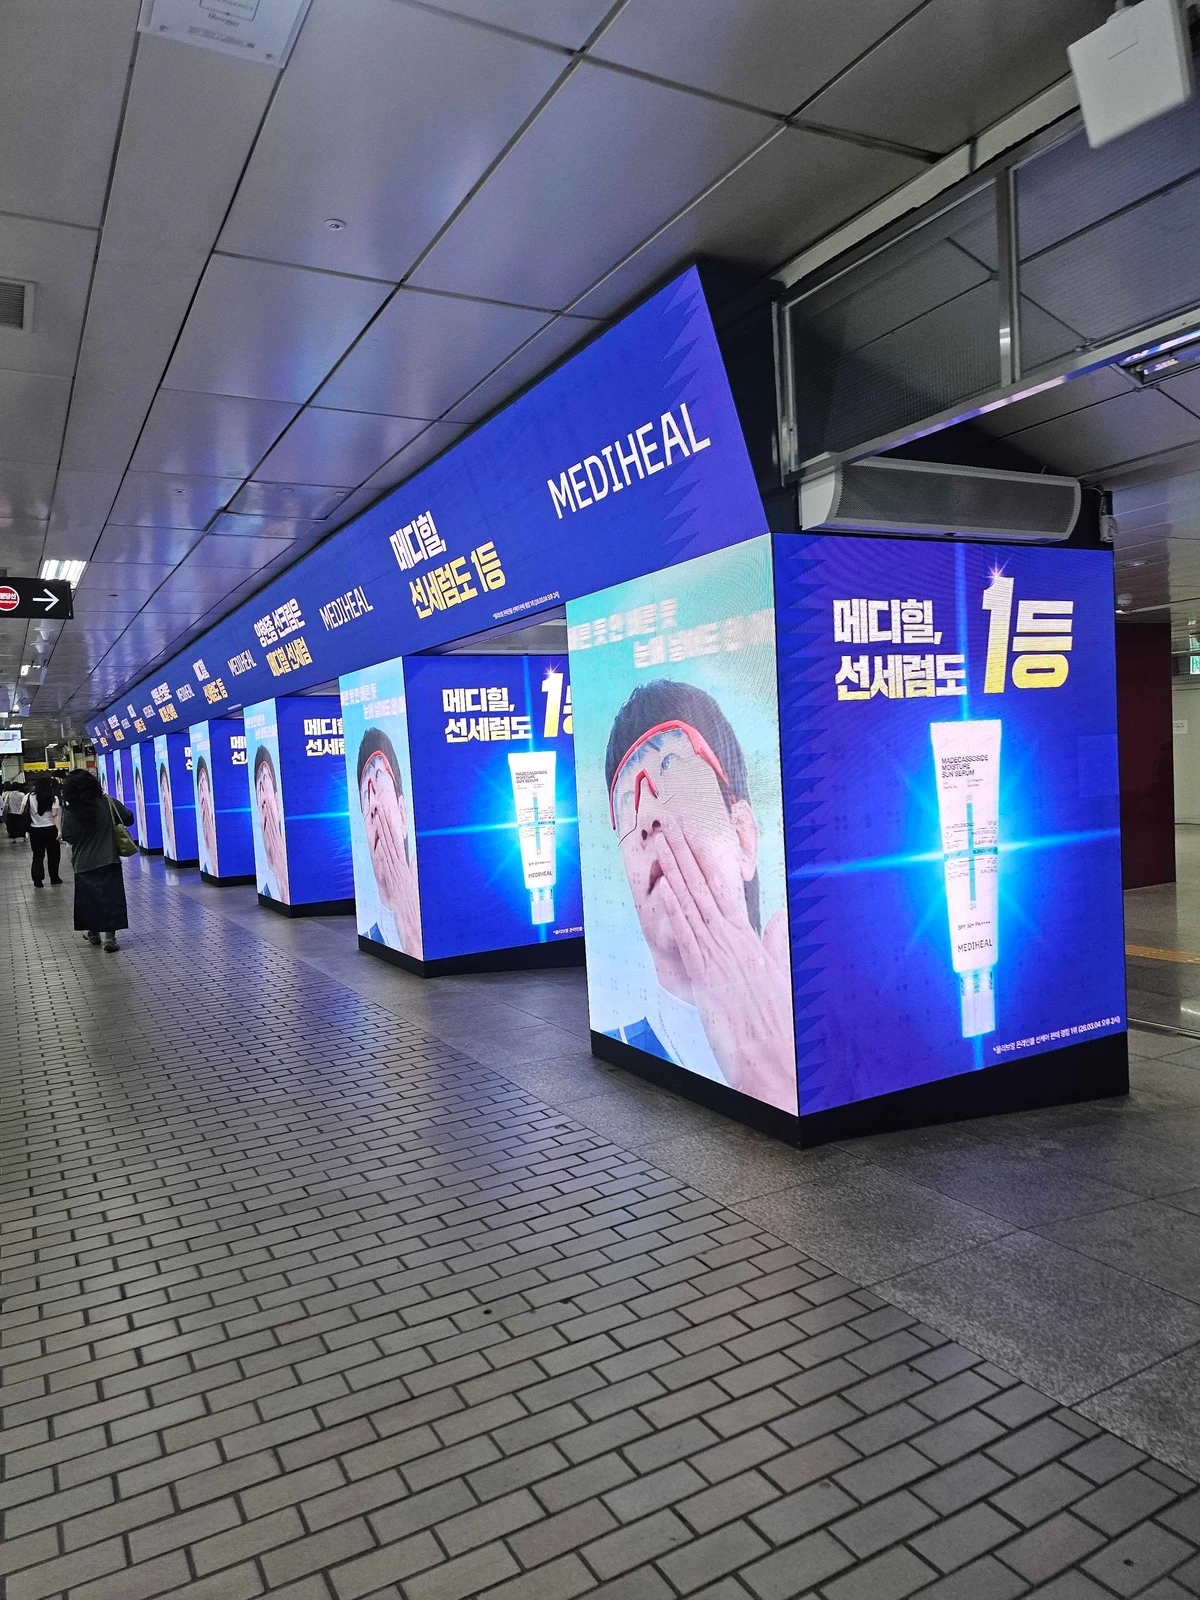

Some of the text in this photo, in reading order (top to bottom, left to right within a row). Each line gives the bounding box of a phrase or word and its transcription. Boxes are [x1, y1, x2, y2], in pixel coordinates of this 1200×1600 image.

[547, 402, 711, 519] MEDIHEAL
[389, 510, 447, 571] 메디힐,
[409, 555, 478, 620] 선세럼도
[471, 540, 506, 592] 1등
[272, 597, 306, 639] 선크림은
[319, 585, 374, 631] MEDIHEAL
[833, 598, 943, 645] 메디힐,
[835, 576, 1074, 701] 선세럼도 1등
[442, 687, 515, 713] 메디힐,
[444, 672, 574, 743] 선세럼도 1
[941, 763, 971, 771] MOISTURE
[955, 769, 975, 777] SERUM
[957, 938, 993, 952] MEDIHEAL
